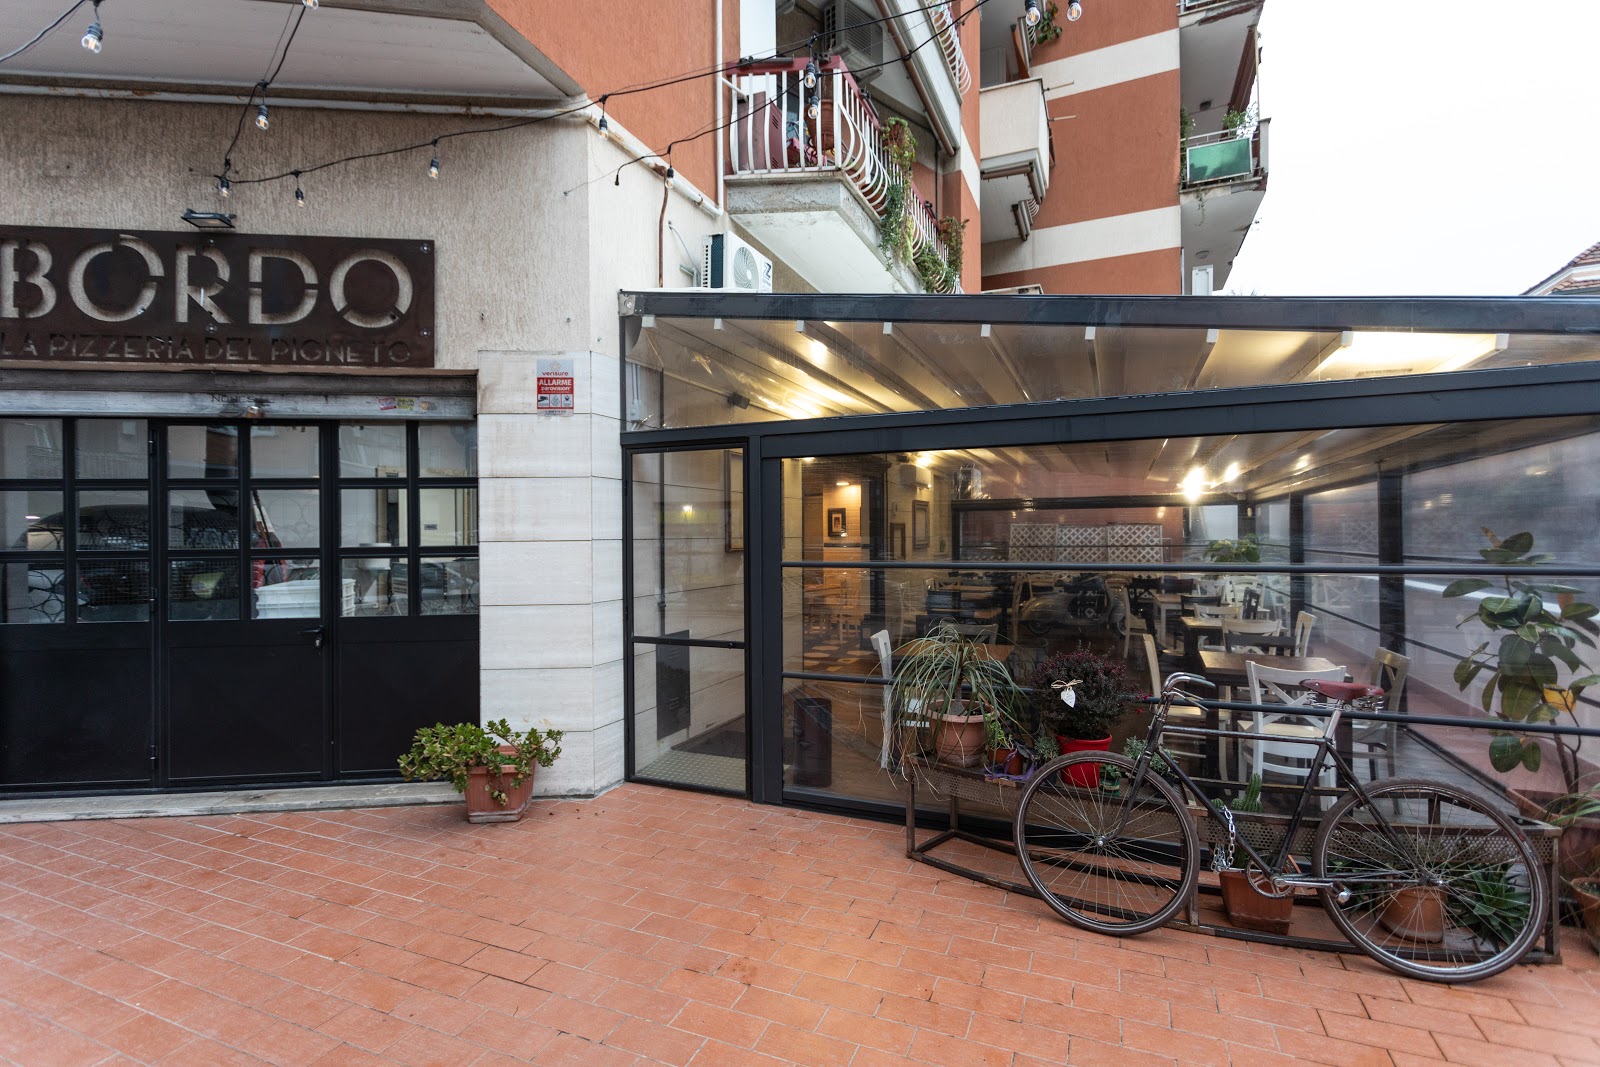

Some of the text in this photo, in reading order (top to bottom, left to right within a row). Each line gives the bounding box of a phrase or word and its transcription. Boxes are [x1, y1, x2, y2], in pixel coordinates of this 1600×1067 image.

[0, 233, 413, 328] BORDO
[1, 331, 410, 364] LA PIZZERIA DEL PIGNETO
